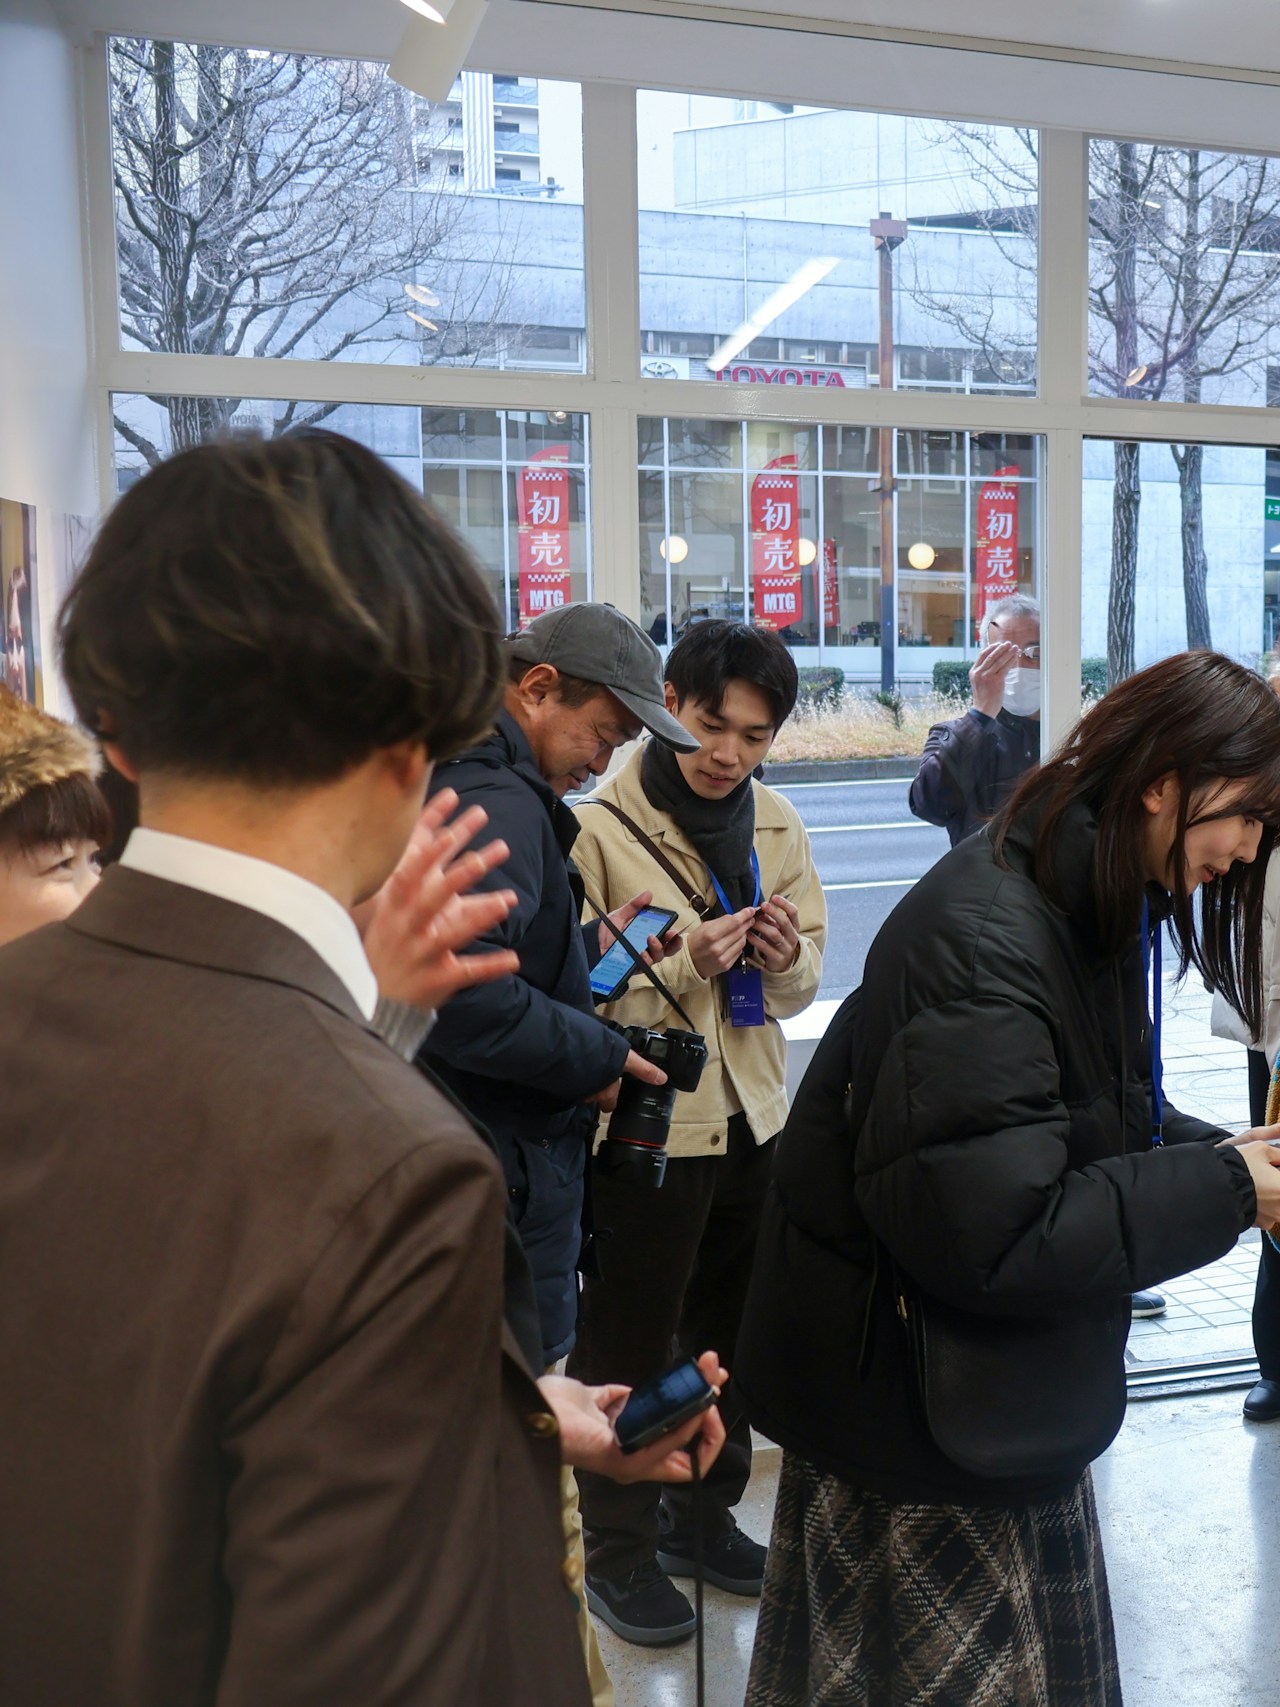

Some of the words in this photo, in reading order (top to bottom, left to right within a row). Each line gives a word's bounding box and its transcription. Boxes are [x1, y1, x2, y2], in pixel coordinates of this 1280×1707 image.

[713, 366, 846, 388] TOYOTA
[527, 491, 563, 567] 初売
[761, 498, 795, 572] 初売
[985, 508, 1014, 579] 初売
[529, 589, 564, 608] MTG
[763, 592, 796, 611] MTG
